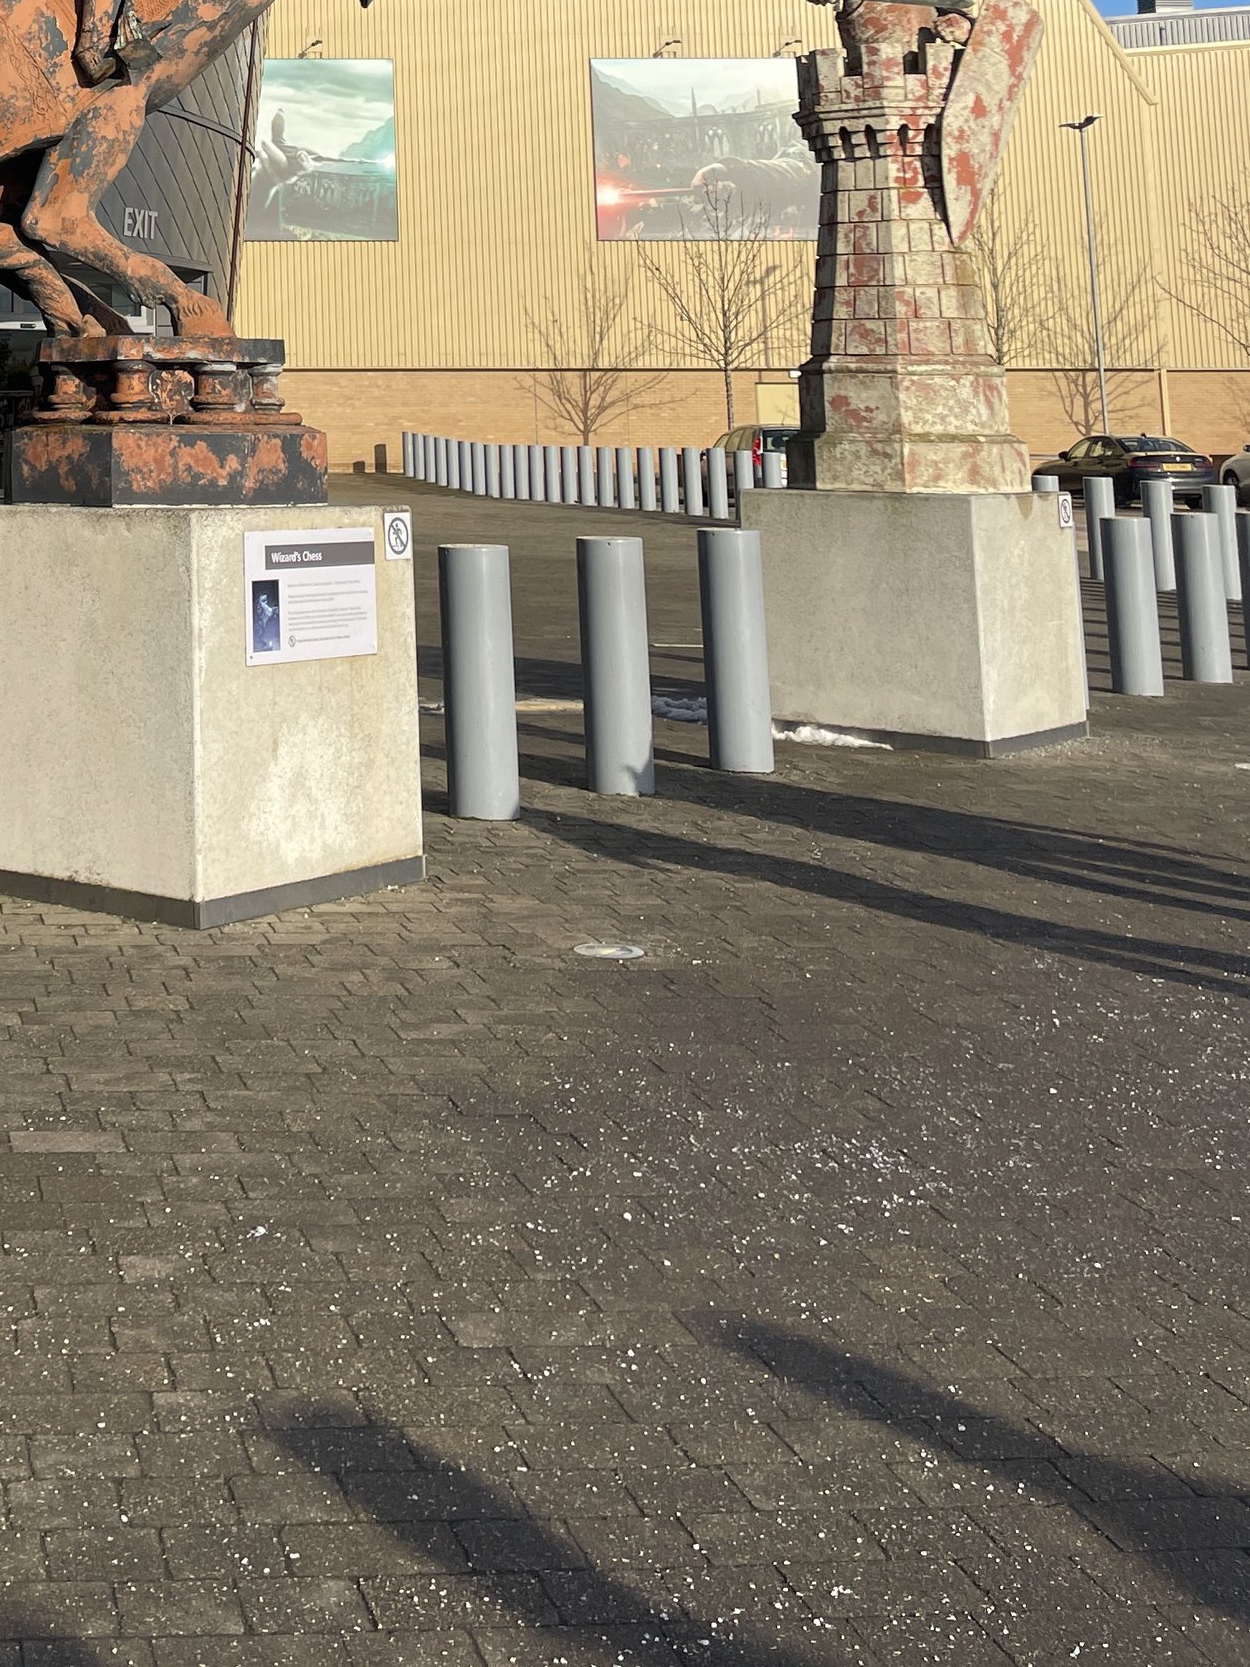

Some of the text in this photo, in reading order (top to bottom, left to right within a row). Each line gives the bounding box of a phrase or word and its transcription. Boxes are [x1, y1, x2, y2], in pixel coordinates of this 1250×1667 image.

[123, 207, 158, 240] EXIT
[271, 551, 323, 563] Wizard's Chess
